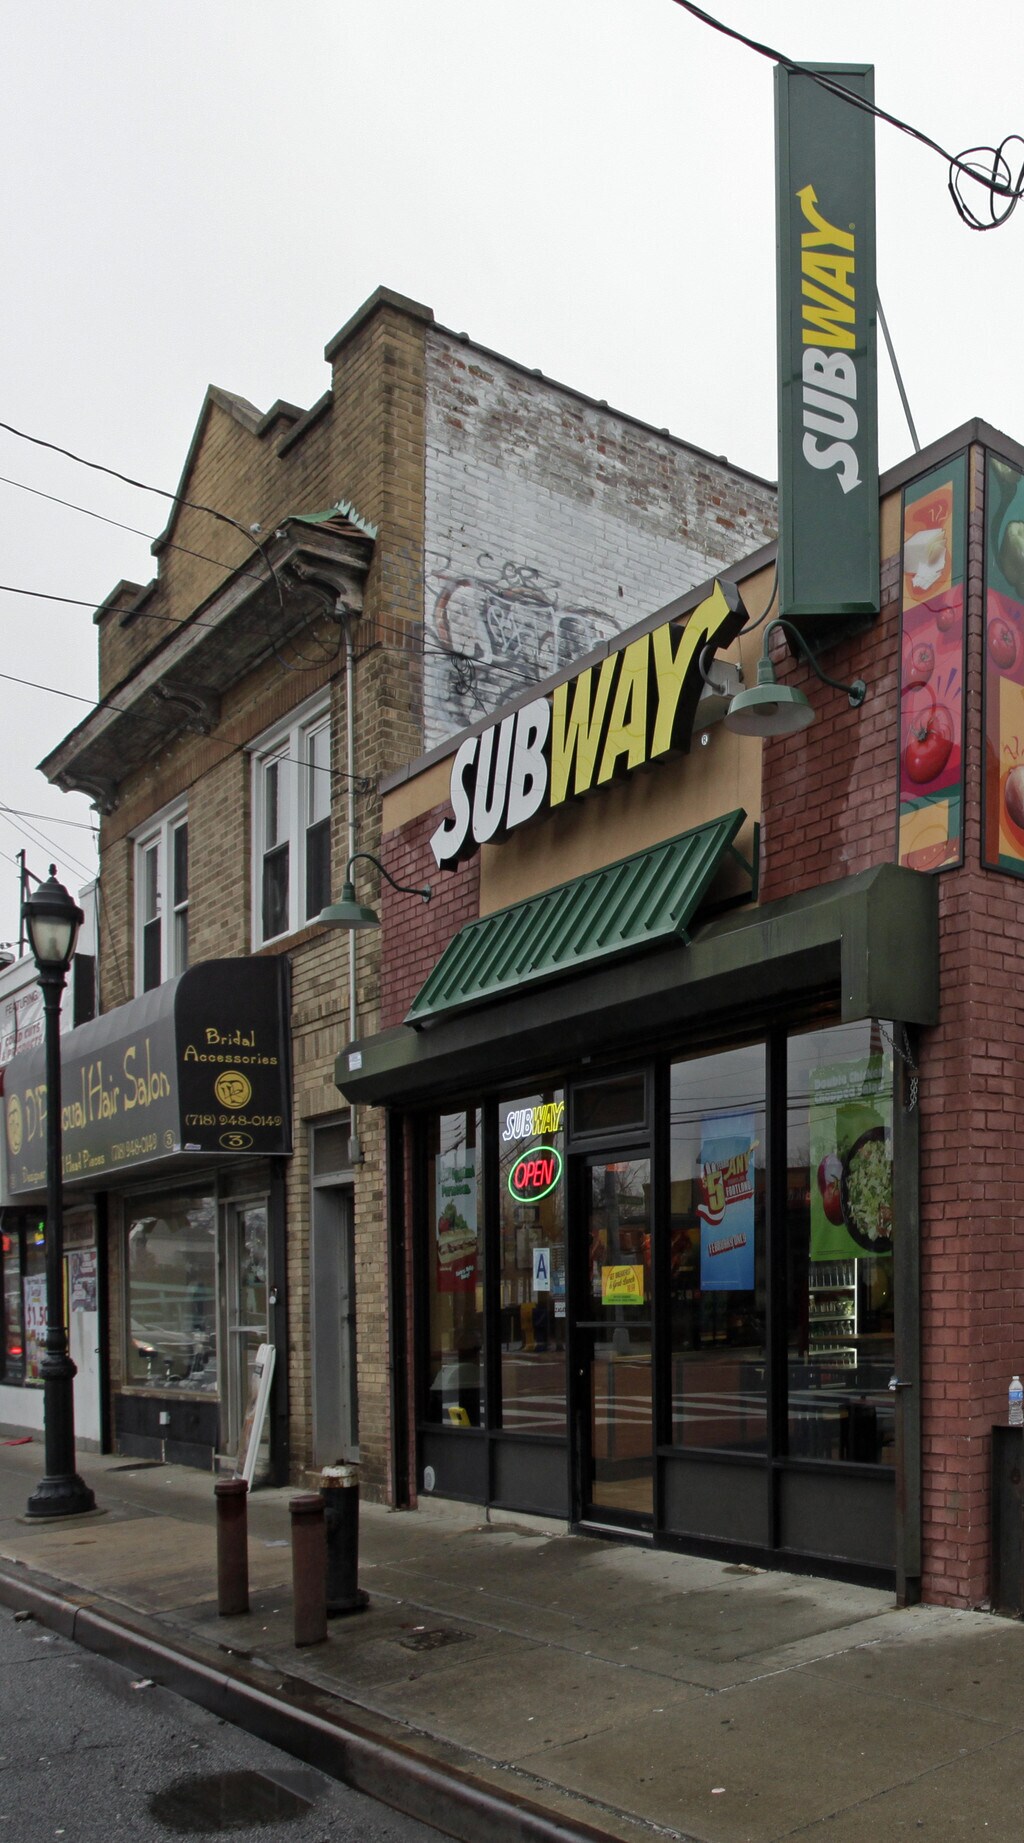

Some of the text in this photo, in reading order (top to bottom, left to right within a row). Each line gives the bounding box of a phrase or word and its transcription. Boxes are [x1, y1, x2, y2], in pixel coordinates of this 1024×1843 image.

[796, 185, 862, 494] SUBWAY
[430, 578, 731, 869] SUBWAY
[205, 1027, 255, 1047] Bridal
[183, 1045, 278, 1065] Accessories
[88, 1060, 120, 1121] Hair
[124, 1038, 171, 1111] Salon
[185, 1114, 282, 1127] (718) 948-0149
[503, 1102, 564, 1141] SUBWAY
[513, 1159, 554, 1188] OPEN
[536, 1253, 547, 1279] A
